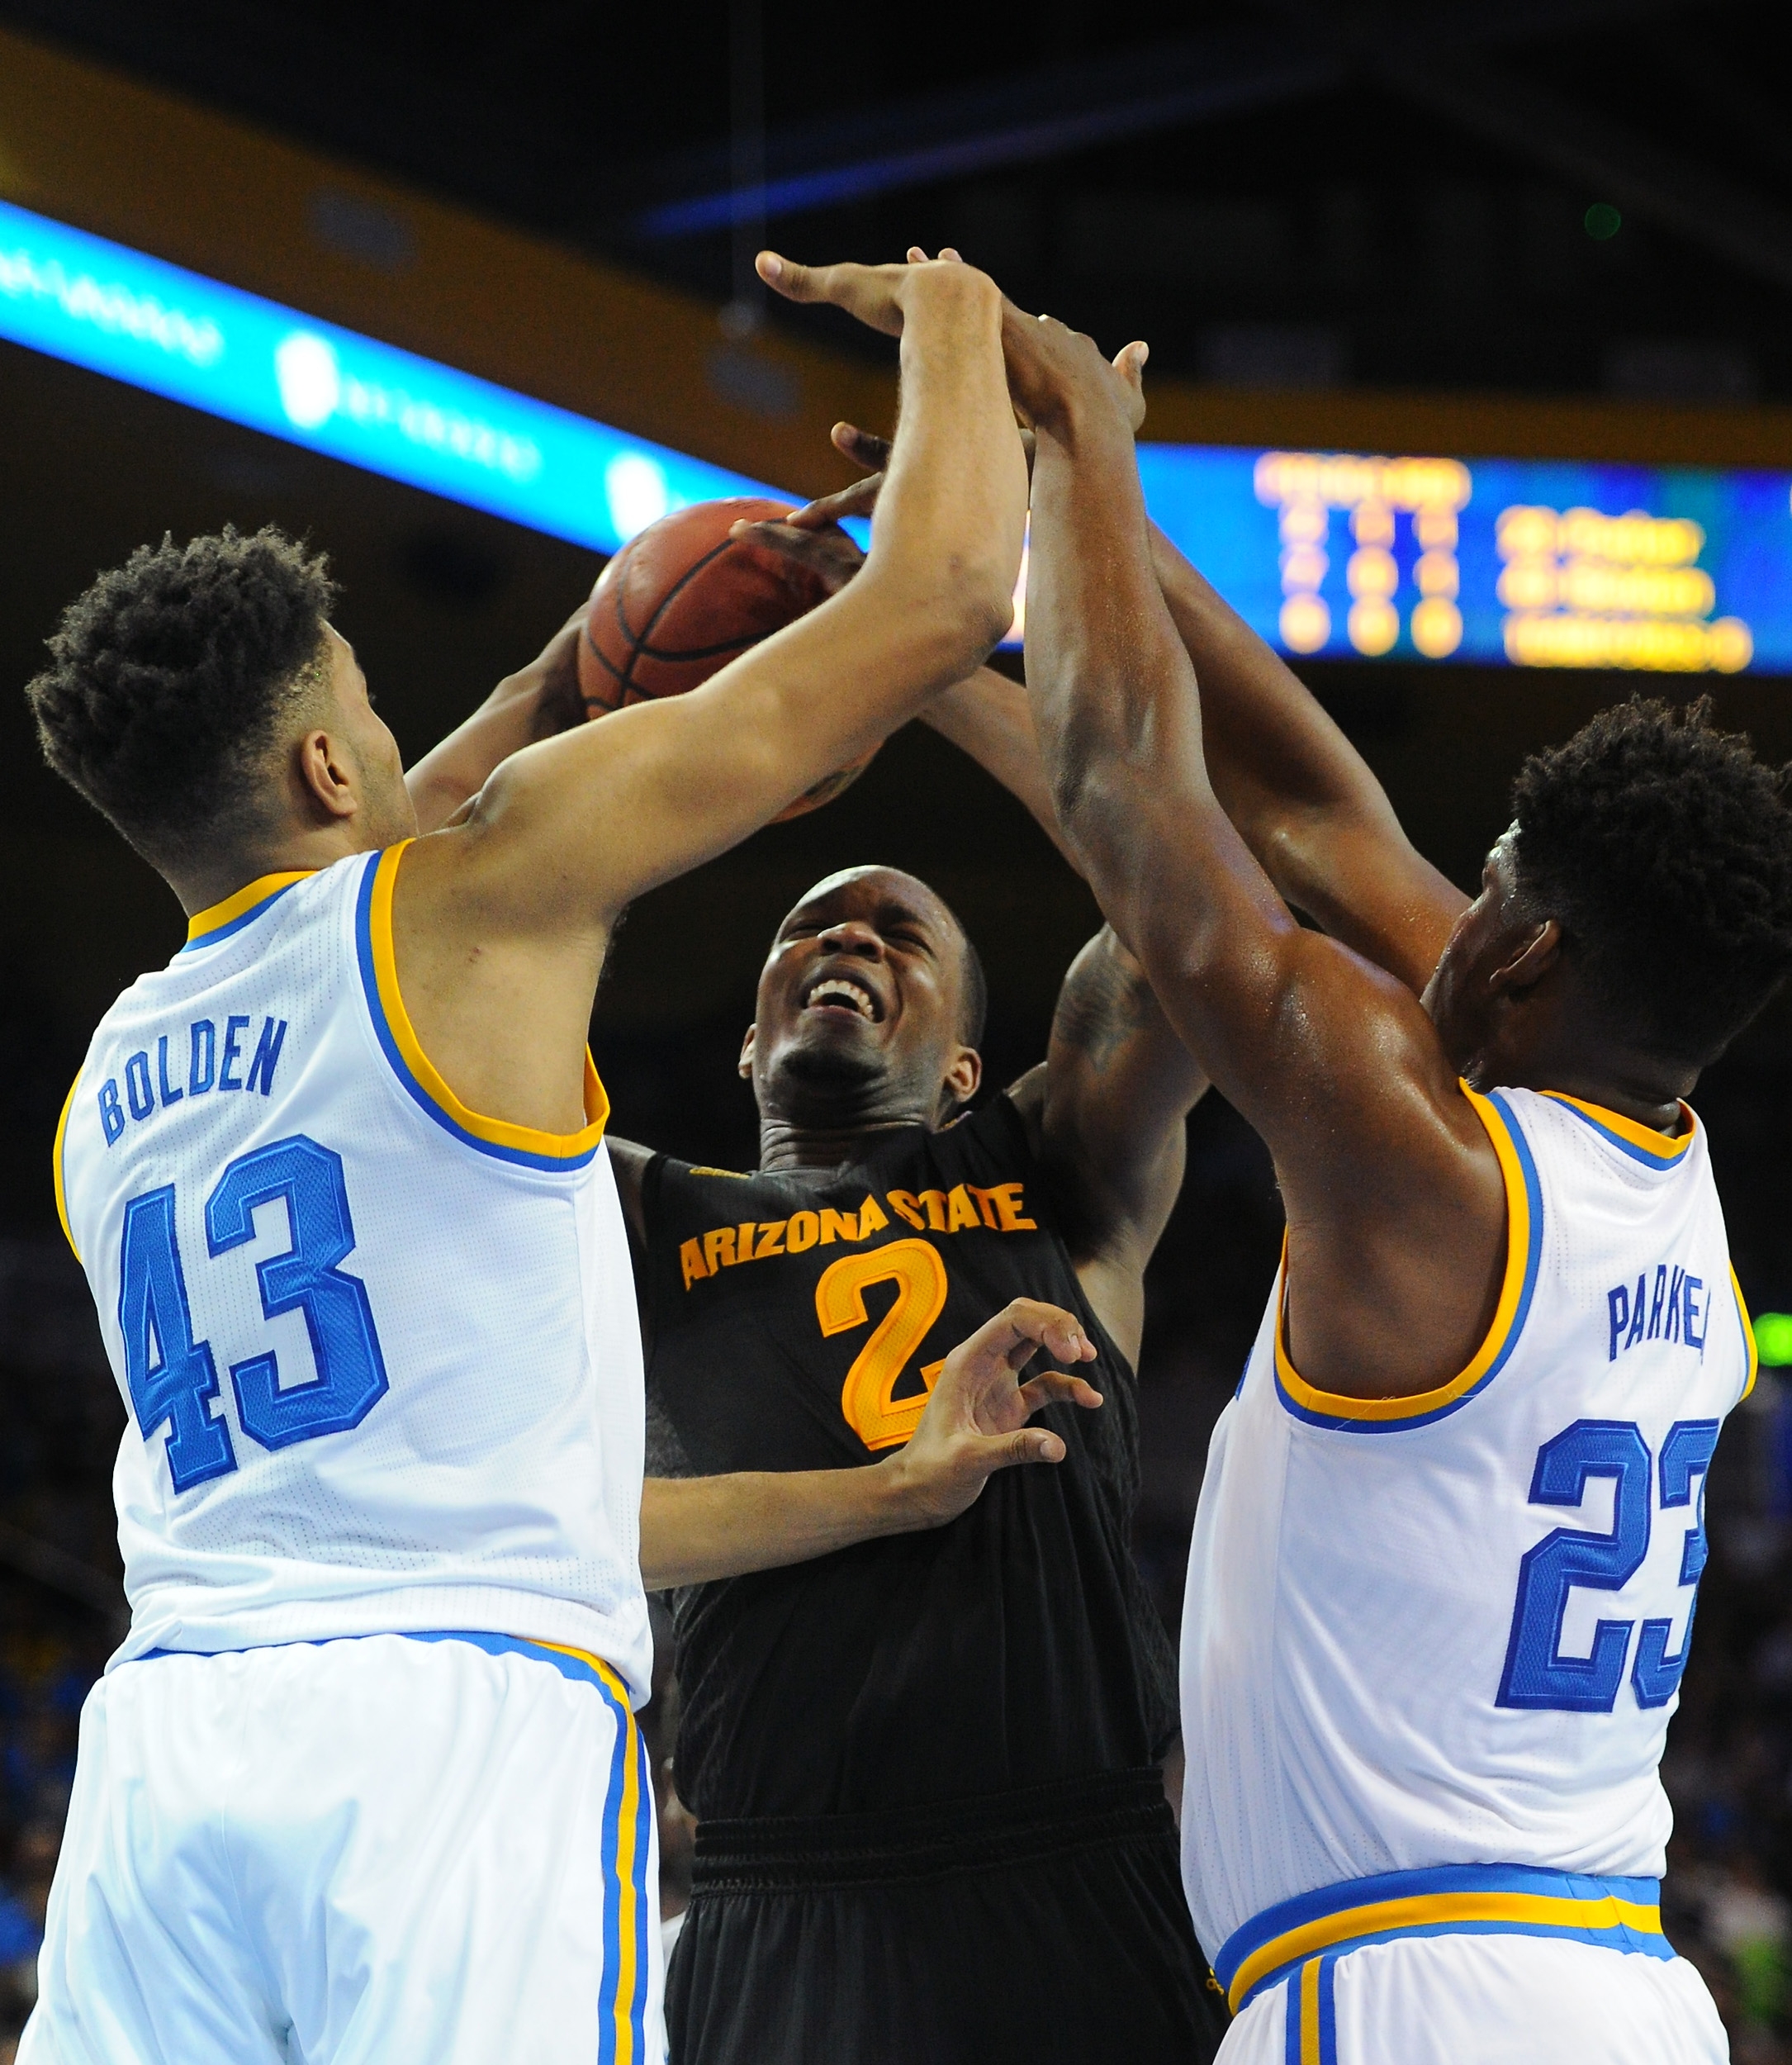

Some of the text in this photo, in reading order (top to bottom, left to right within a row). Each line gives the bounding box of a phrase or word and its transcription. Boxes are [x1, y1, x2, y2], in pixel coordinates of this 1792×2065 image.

[97, 1015, 287, 1147] BOLDEN
[118, 1133, 390, 1495] 43
[679, 1183, 1038, 1291] ARIZONA STATE
[1607, 1263, 1711, 1365] PARKE
[814, 1237, 948, 1451] 2
[1495, 1417, 1719, 1713] 23
